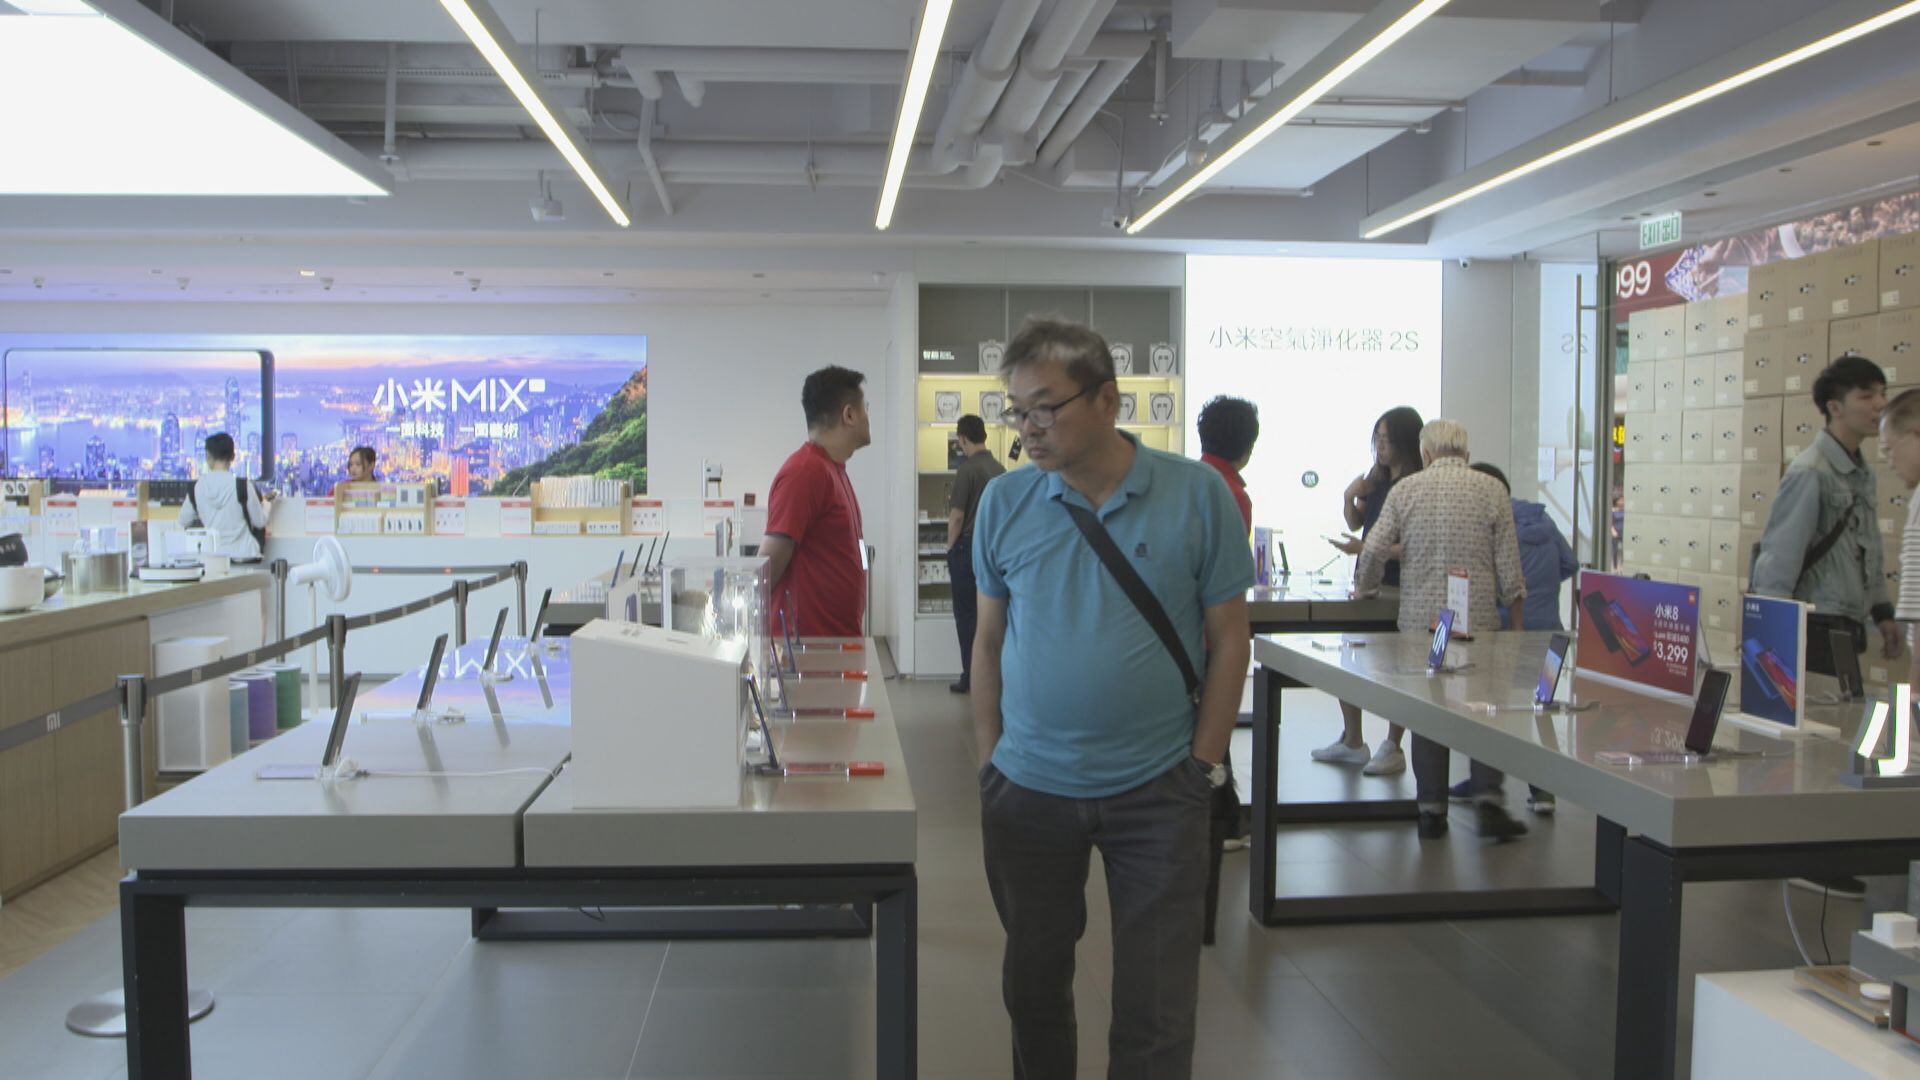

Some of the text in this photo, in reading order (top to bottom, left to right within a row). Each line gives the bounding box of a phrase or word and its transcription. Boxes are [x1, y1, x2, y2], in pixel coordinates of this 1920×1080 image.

[1642, 216, 1680, 247] EXIT 出口
[1389, 330, 1419, 351] 2S
[1655, 602, 1679, 621] 小米8
[1653, 640, 1688, 664] $3,299
